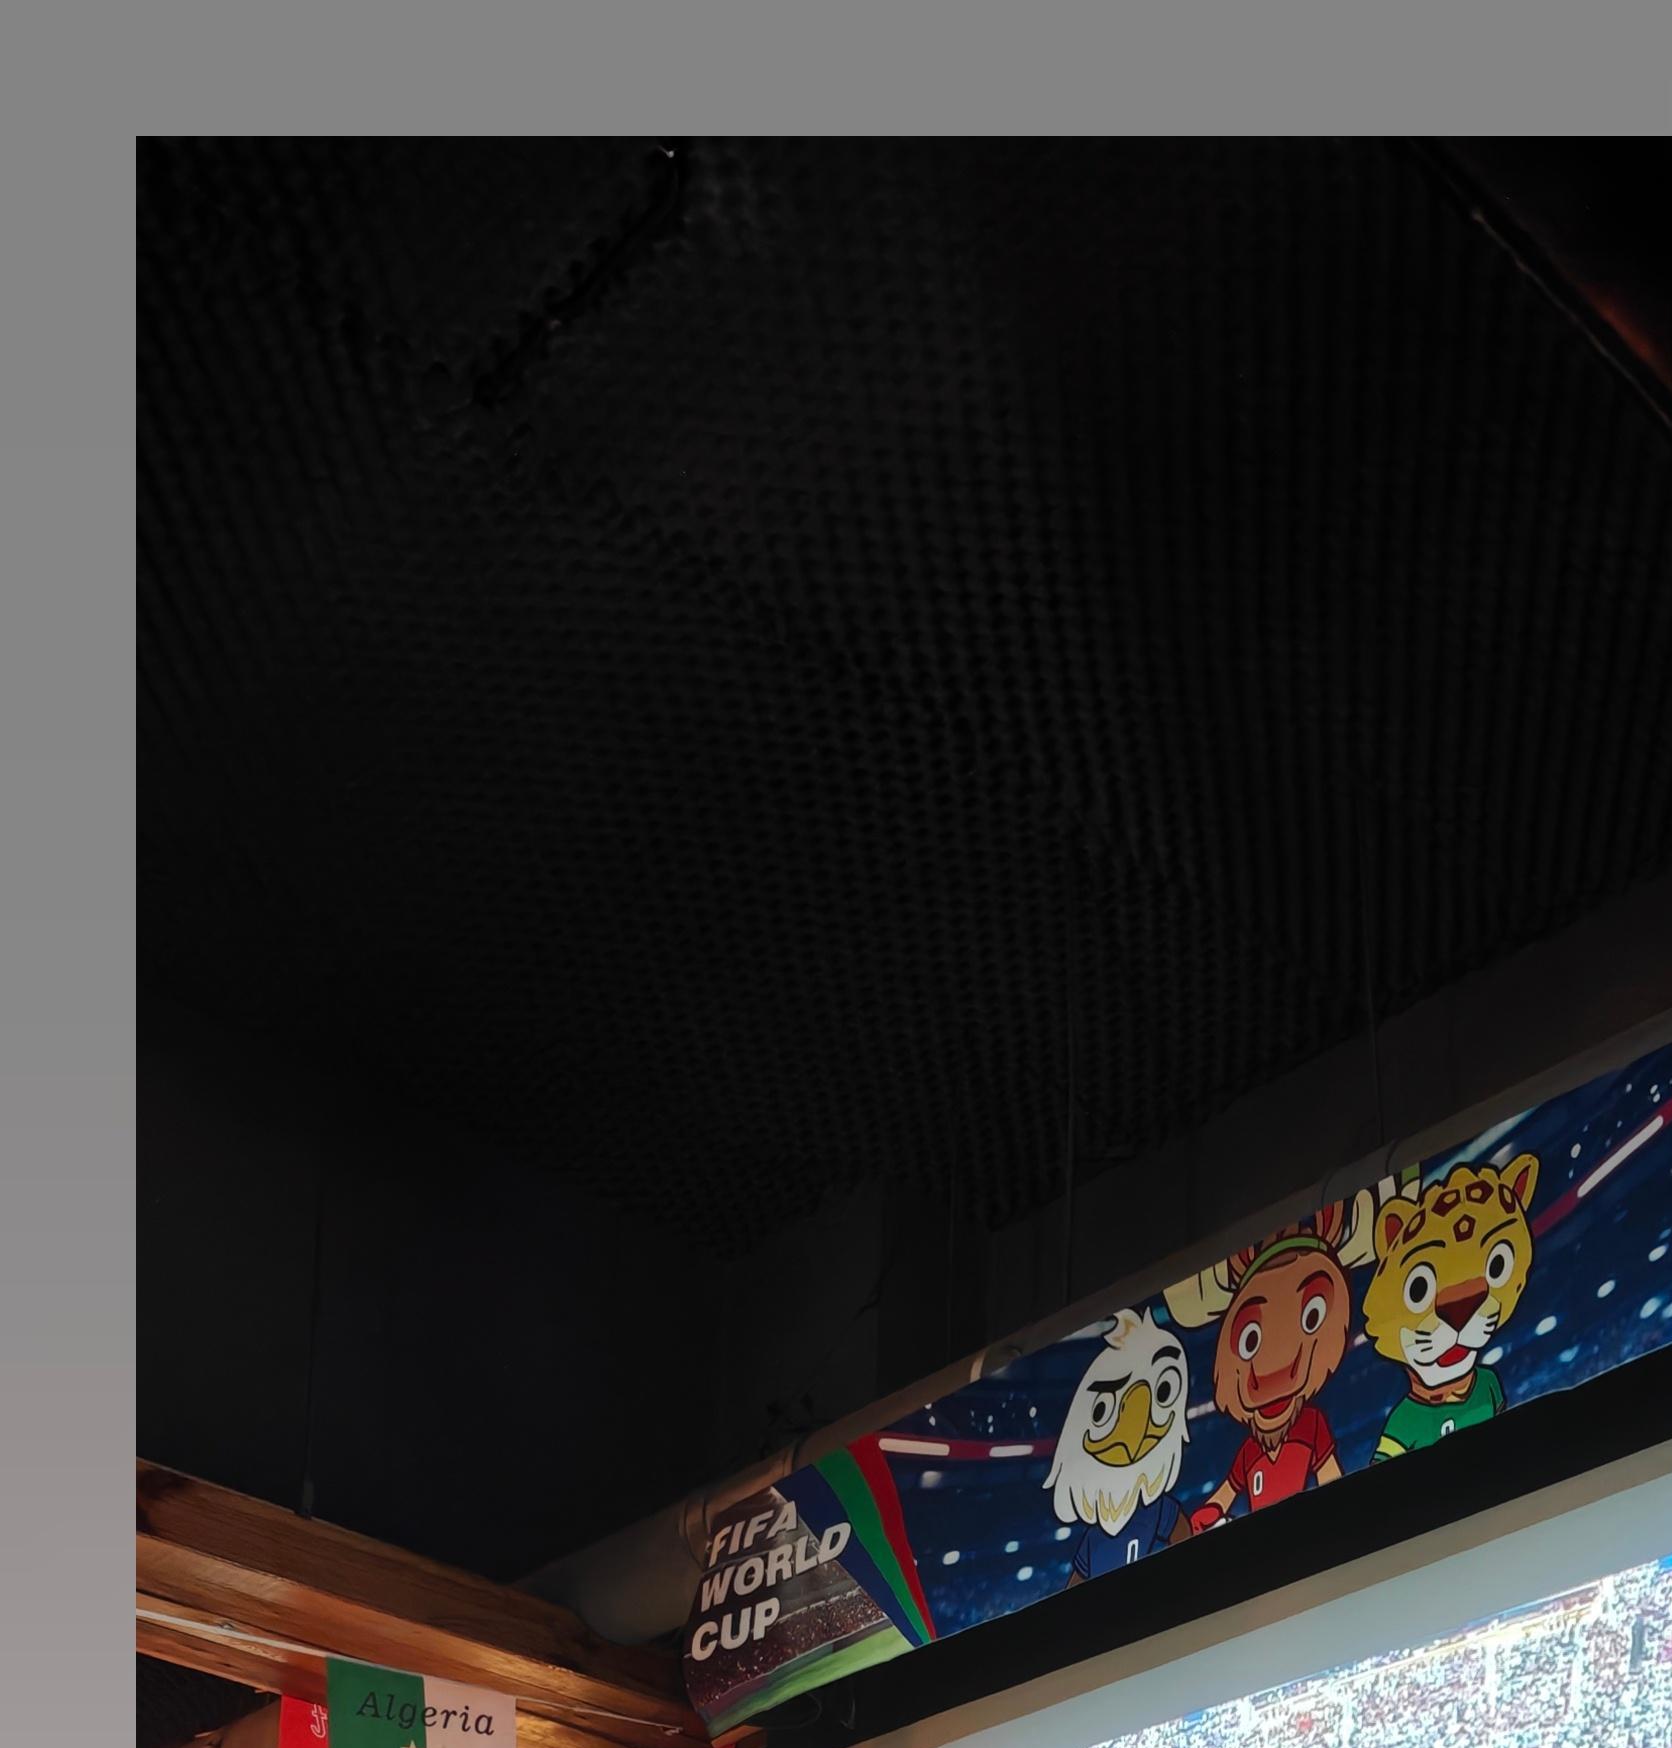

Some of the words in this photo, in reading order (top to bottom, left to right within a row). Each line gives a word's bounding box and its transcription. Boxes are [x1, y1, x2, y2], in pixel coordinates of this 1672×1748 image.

[700, 1521, 852, 1613] WORLD
[707, 1500, 798, 1568] FIFA
[690, 1596, 781, 1662] CUP
[355, 1691, 496, 1738] Algeria
